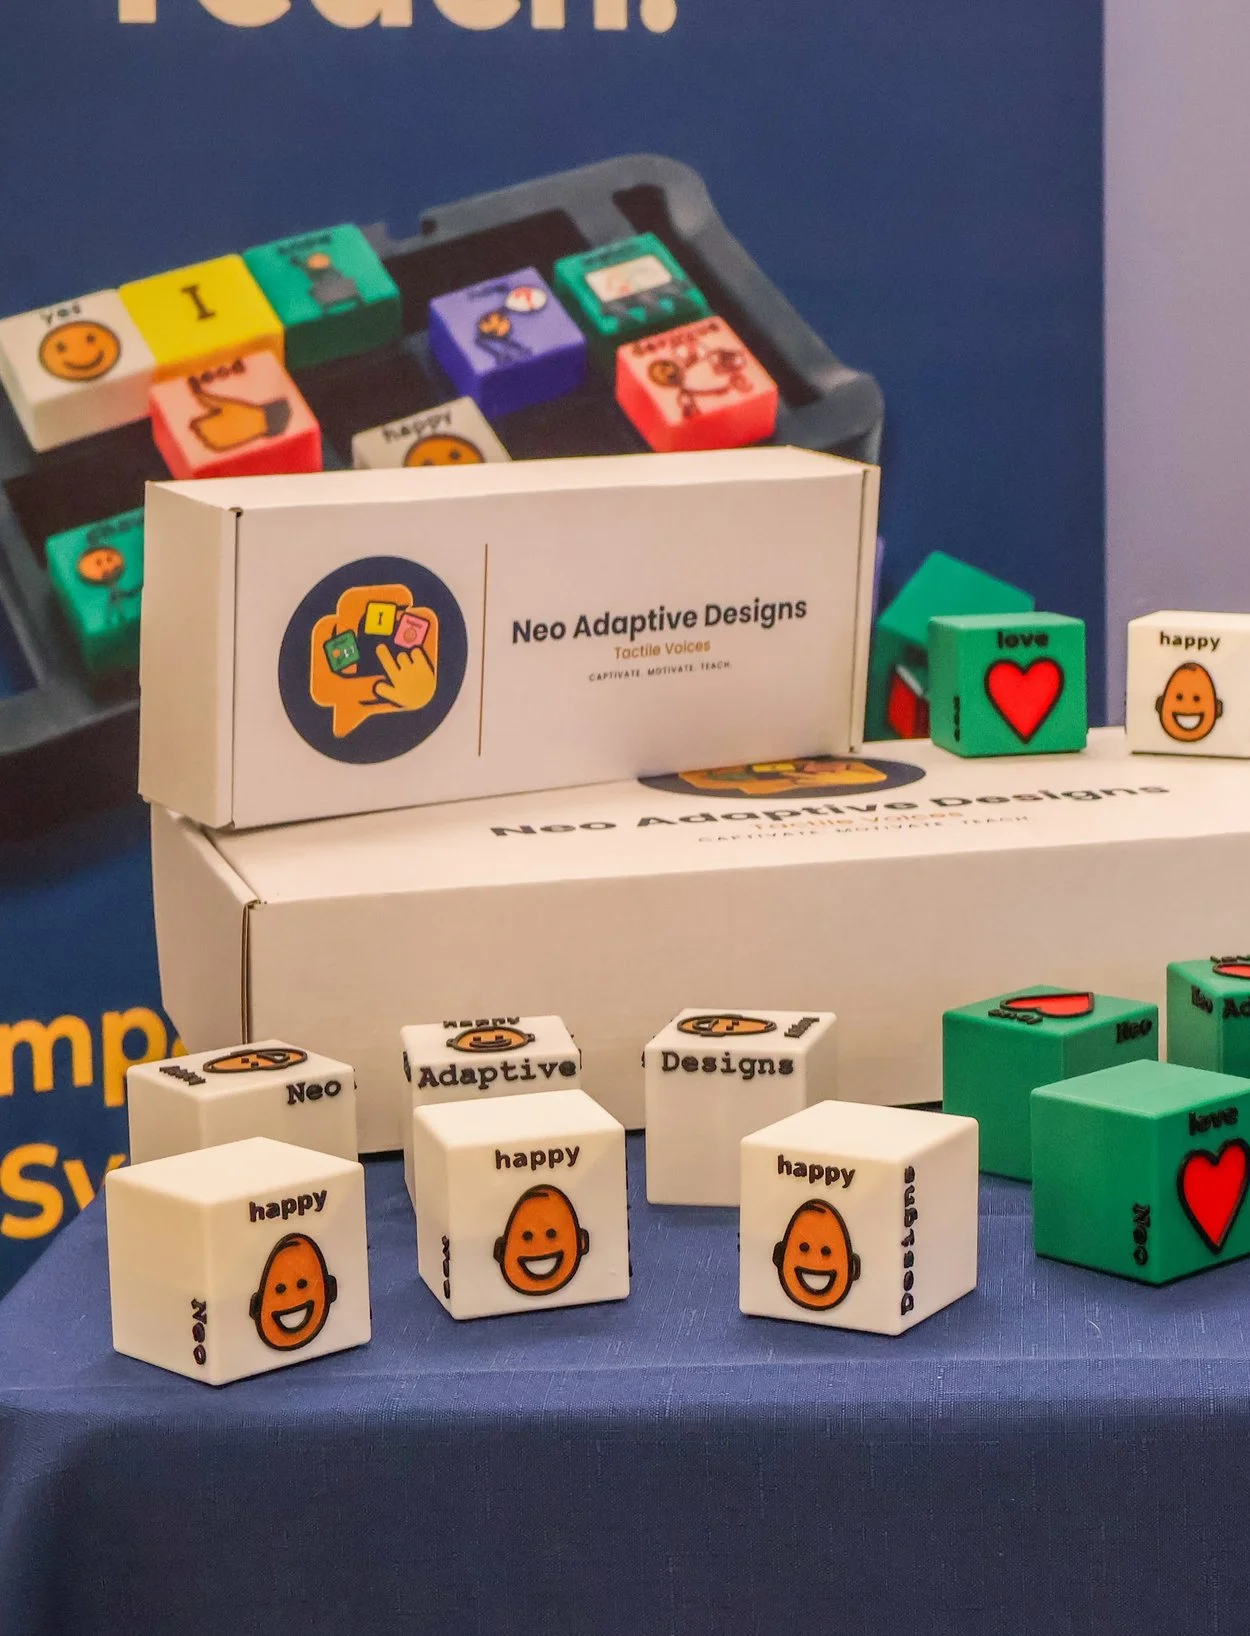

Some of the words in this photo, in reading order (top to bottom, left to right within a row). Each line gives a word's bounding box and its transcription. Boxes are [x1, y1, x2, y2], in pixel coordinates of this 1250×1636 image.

[181, 284, 216, 321] I
[512, 618, 567, 645] Neo
[573, 605, 698, 642] Adaptive
[704, 597, 808, 630] Designs
[614, 643, 661, 660] Tactile
[665, 640, 711, 657] Voices
[997, 630, 1049, 649] love
[1159, 631, 1221, 652] happy
[588, 669, 643, 683] CAPTIVATE.
[647, 664, 697, 677] MOTIVATE.
[490, 821, 617, 838] Neo
[636, 803, 919, 828] Adaptive
[929, 786, 1170, 807] Designs
[0, 1006, 189, 1107] mp
[661, 1051, 794, 1080] Designs
[418, 1058, 577, 1091] Adaptive
[286, 1080, 342, 1105] Neo
[1188, 1106, 1239, 1135] love
[495, 1145, 580, 1171] happy
[777, 1154, 856, 1189] happy
[248, 1189, 328, 1223] happy
[1132, 1203, 1152, 1266] Neo
[191, 1298, 208, 1366] Neo
